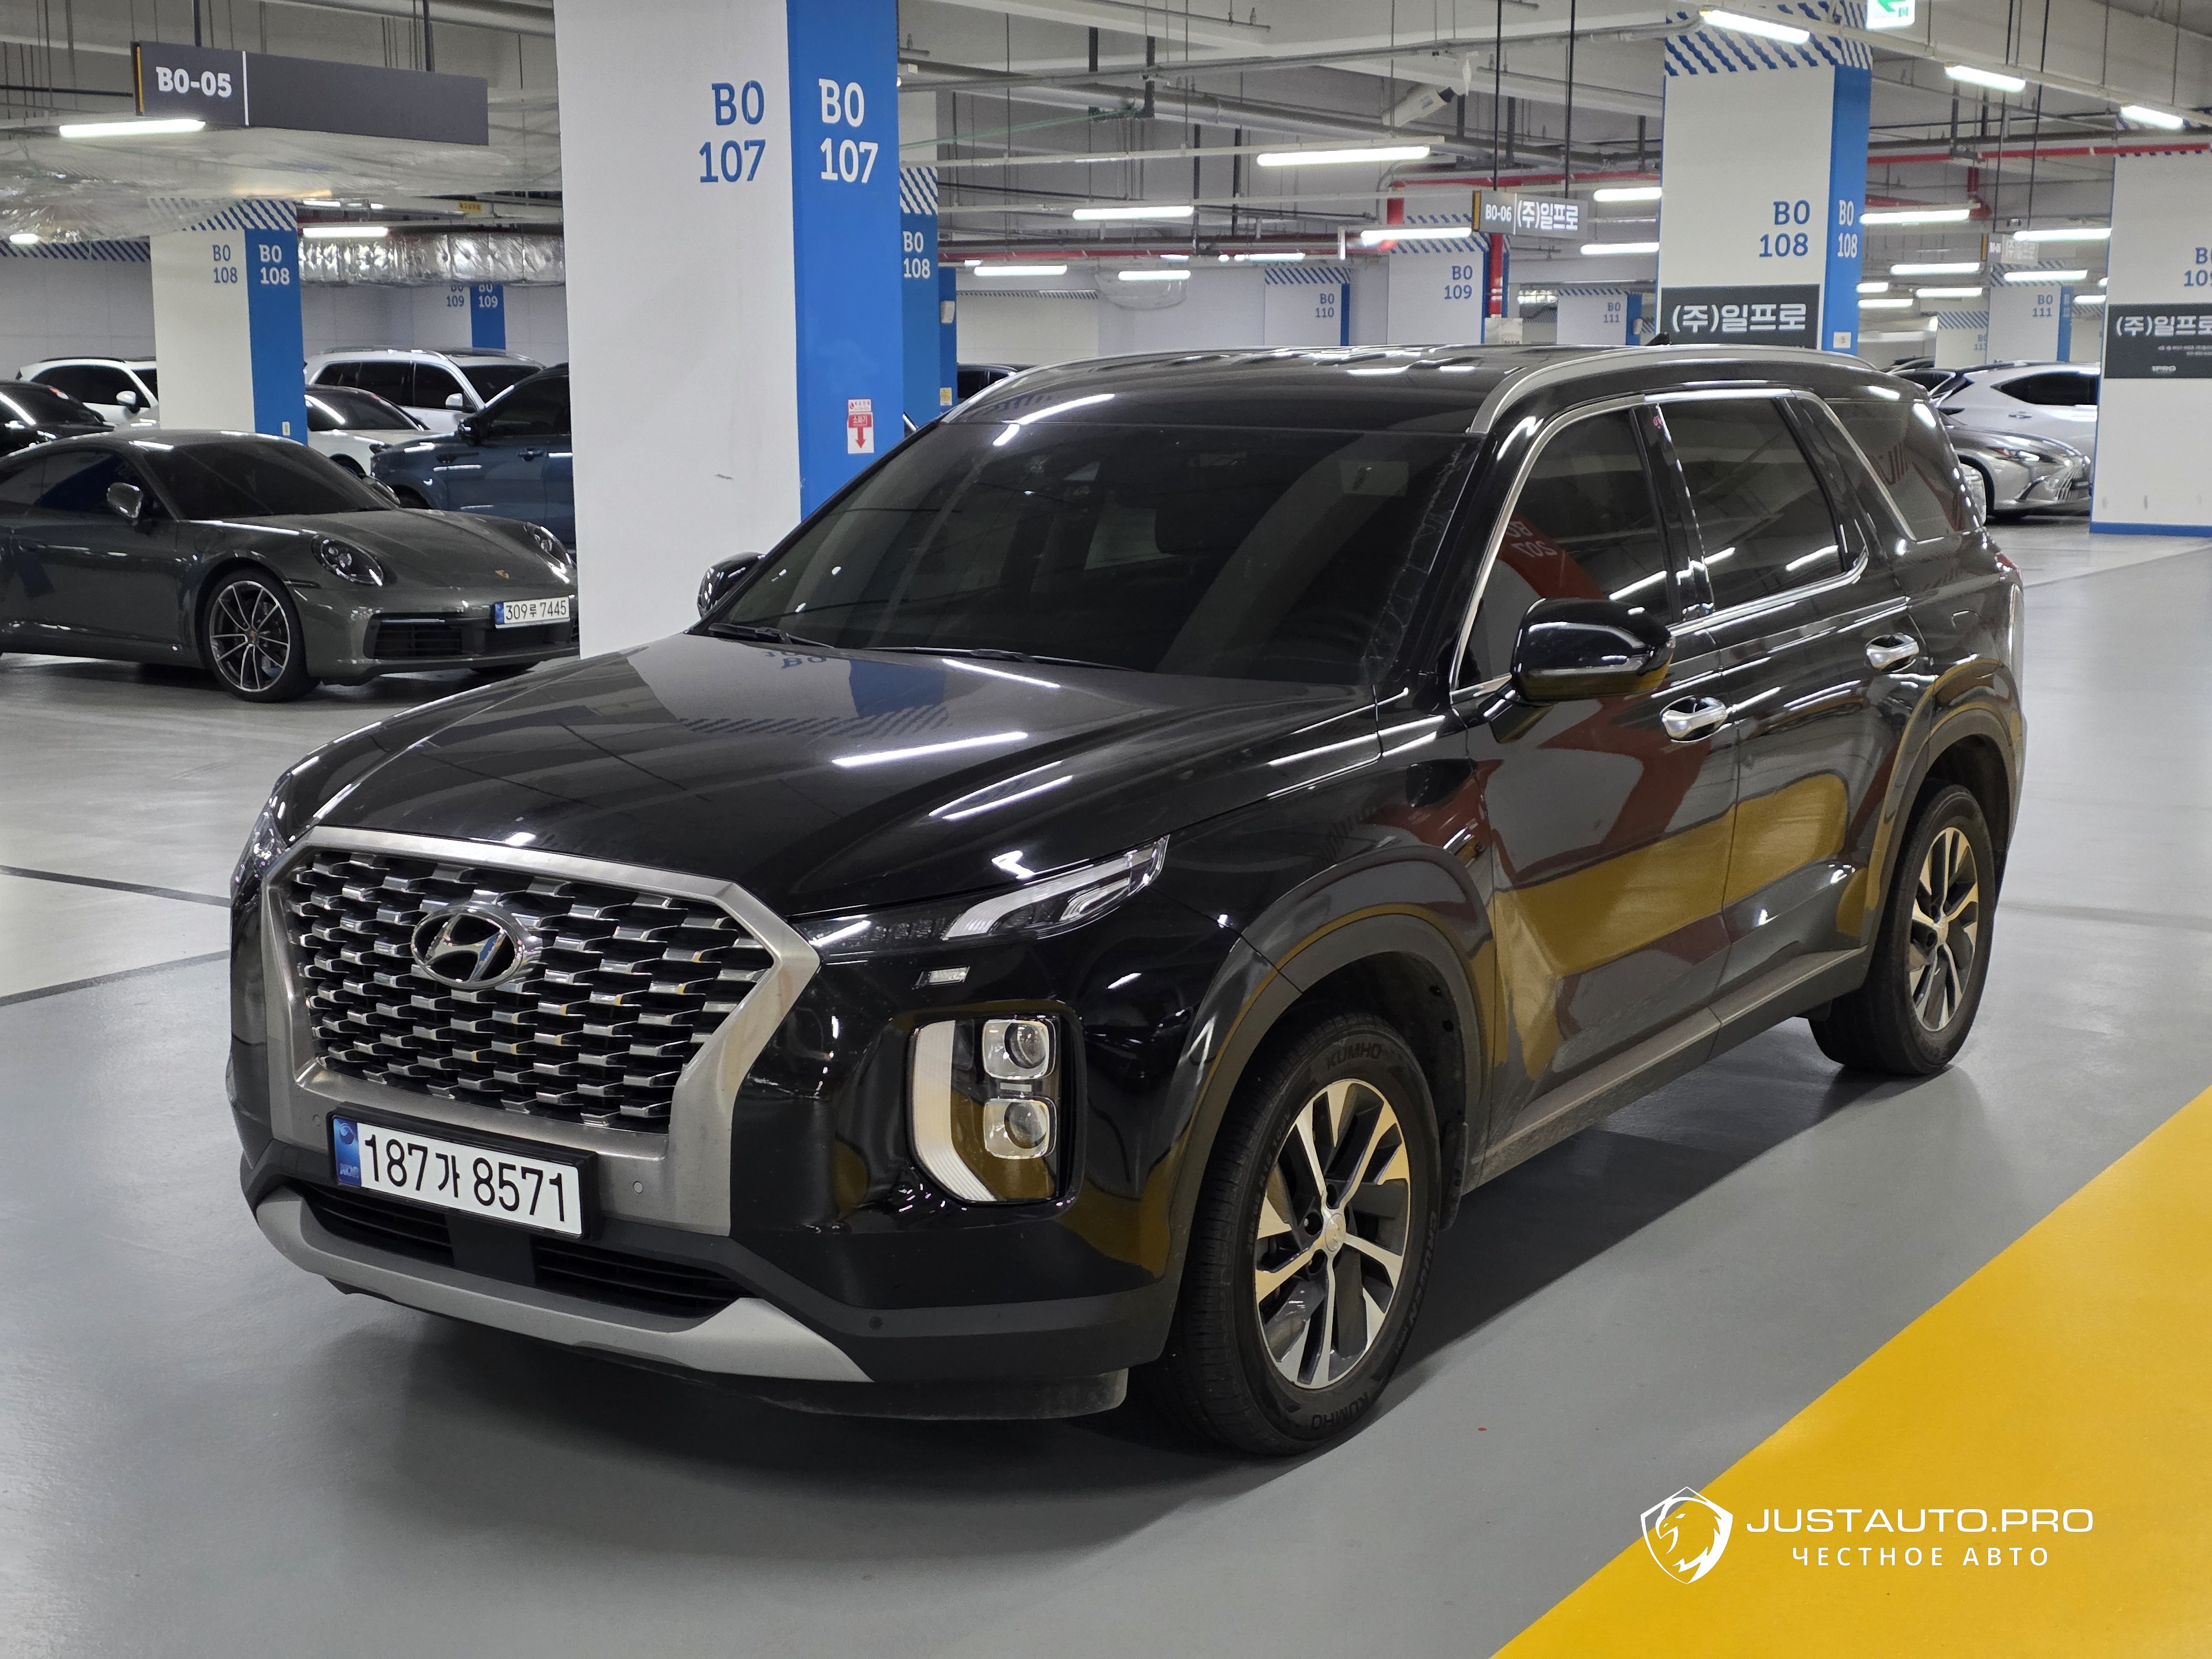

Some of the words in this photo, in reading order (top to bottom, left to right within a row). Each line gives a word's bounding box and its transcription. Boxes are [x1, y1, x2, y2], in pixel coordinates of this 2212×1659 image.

[699, 139, 766, 183] 107
[820, 137, 879, 184] 107
[1517, 200, 1579, 231] (주)일프로
[1759, 232, 1809, 257] 108
[1837, 232, 1858, 258] 108
[2195, 247, 2212, 265] B
[213, 267, 238, 284] 108
[259, 268, 290, 285] 108
[903, 258, 931, 279] 108
[2183, 269, 2212, 287] 10
[446, 295, 465, 307] 109
[478, 295, 498, 308] 109
[1444, 285, 1473, 300] 109
[1315, 307, 1334, 319] 110
[1603, 314, 1620, 323] 111
[1672, 303, 1806, 333] (주)일프로
[2032, 307, 2053, 317] 111
[540, 599, 567, 618] 7445
[1327, 1042, 1382, 1071] KUMHO
[340, 1162, 359, 1178] KOR
[364, 1134, 461, 1198] 187가
[473, 1157, 565, 1222] 8571
